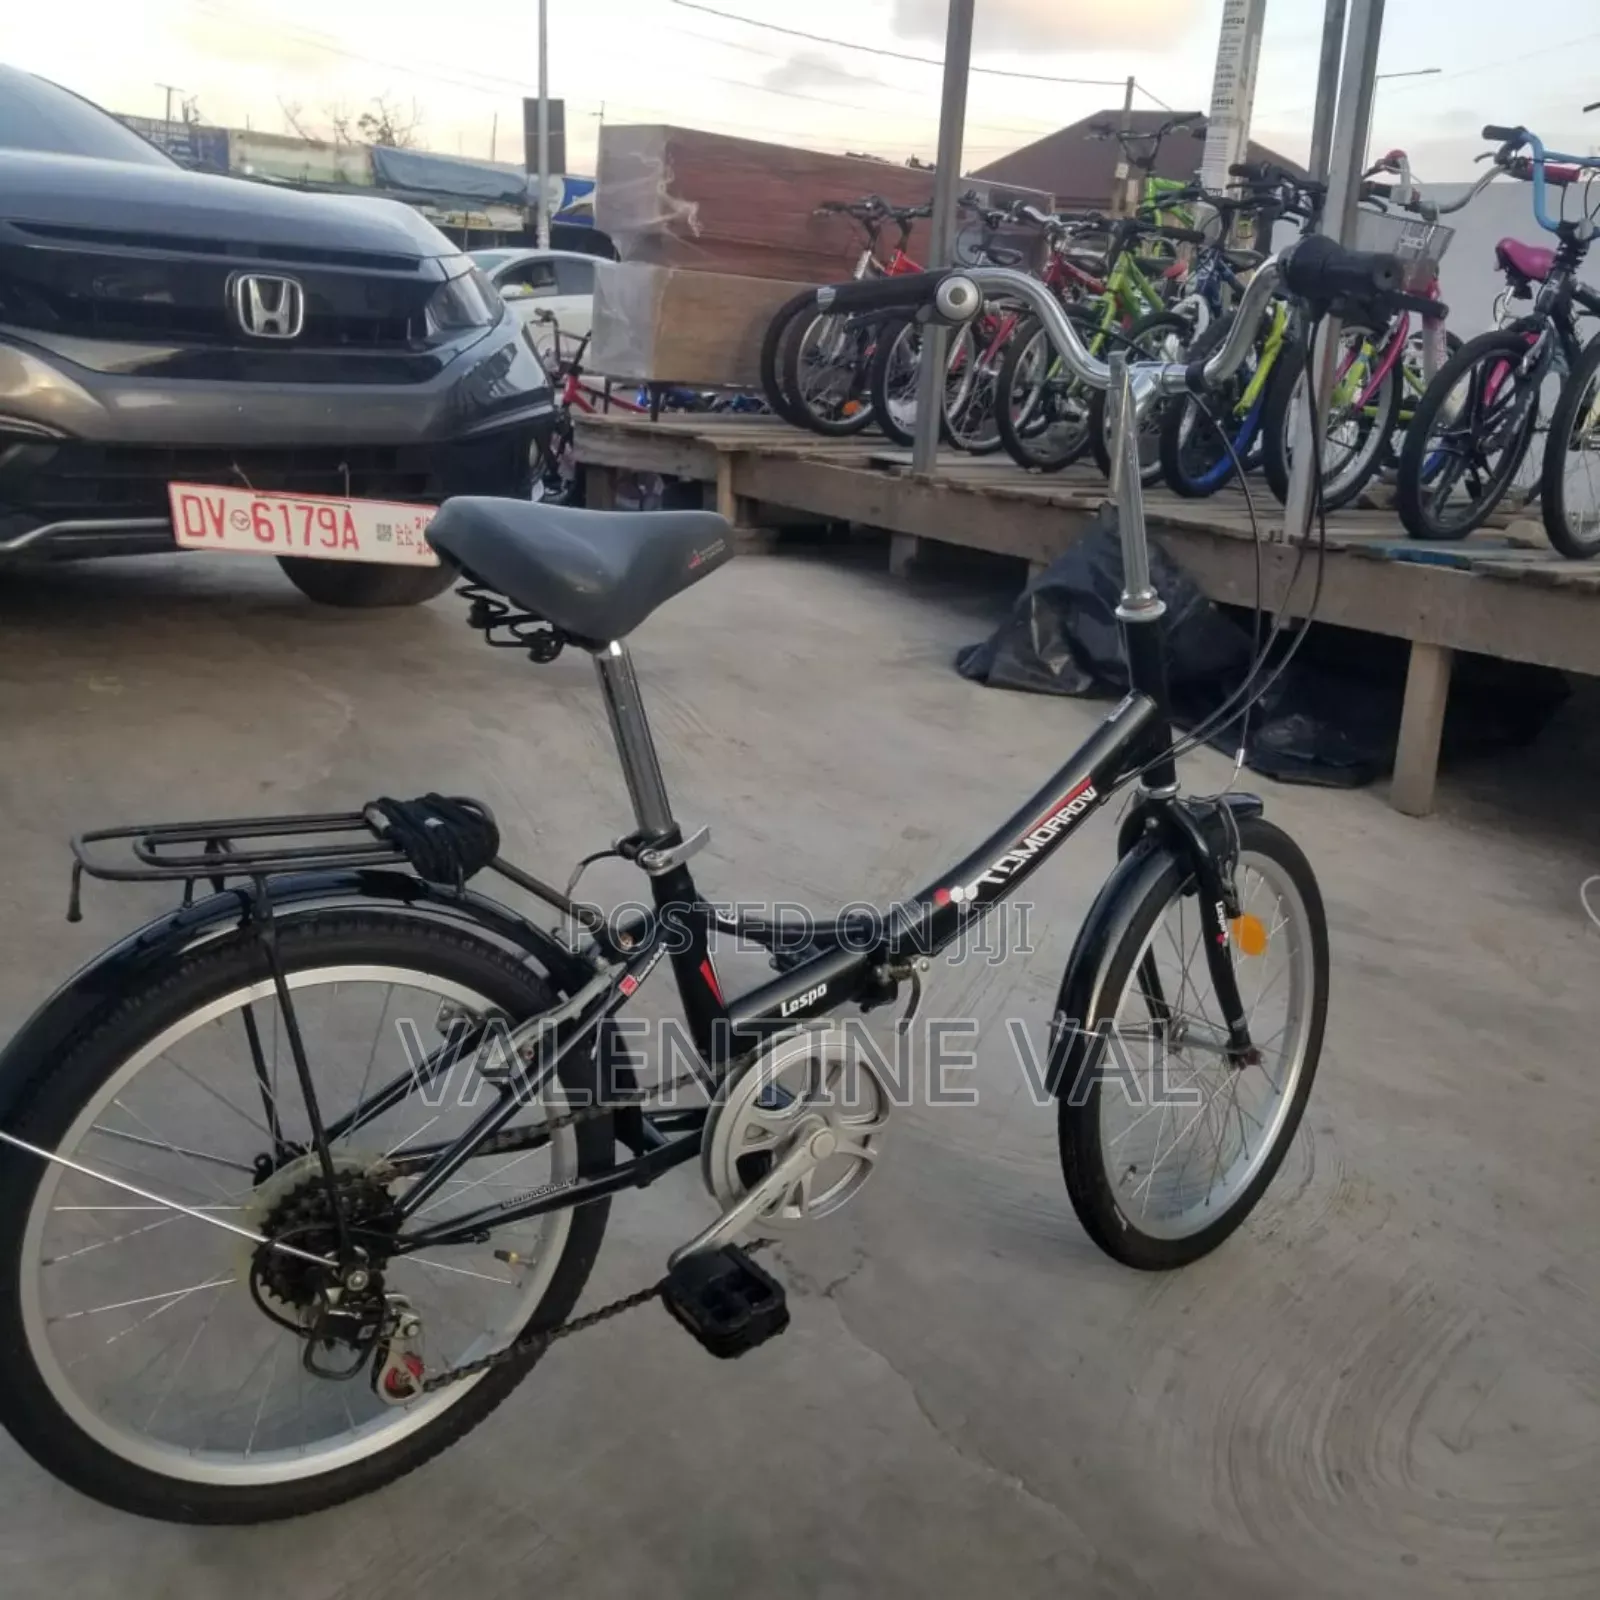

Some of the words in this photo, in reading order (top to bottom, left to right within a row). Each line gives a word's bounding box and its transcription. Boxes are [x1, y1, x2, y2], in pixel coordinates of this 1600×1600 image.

[180, 494, 226, 538] DV
[251, 501, 359, 551] 6179A
[975, 785, 1099, 884] TOMORROW
[781, 983, 827, 1017] Lespo
